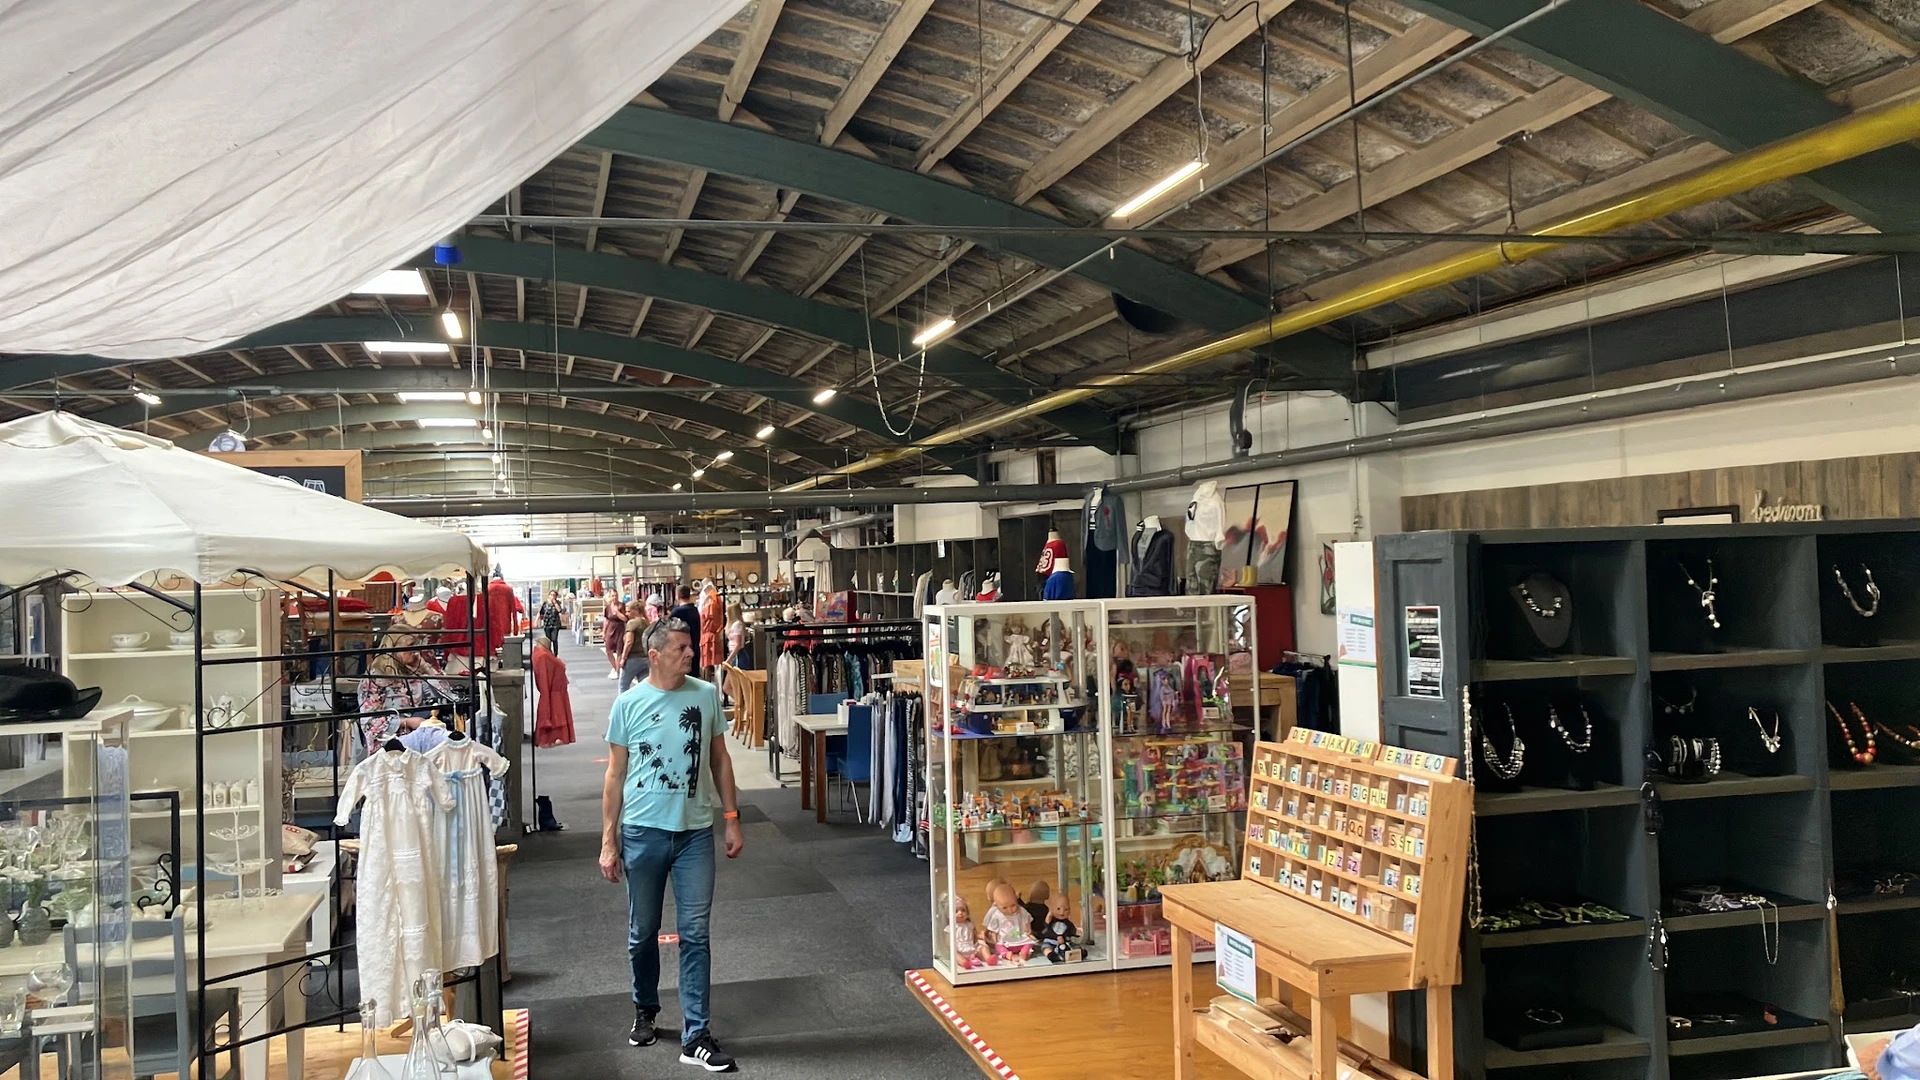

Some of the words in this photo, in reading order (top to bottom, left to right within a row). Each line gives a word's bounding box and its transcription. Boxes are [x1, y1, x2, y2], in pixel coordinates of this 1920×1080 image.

[1751, 489, 1823, 523] bedroom
[1292, 729, 1306, 741] DE
[1312, 733, 1343, 750] ZAAK
[1349, 741, 1370, 755] VAN
[1386, 750, 1442, 770] ERMELO
